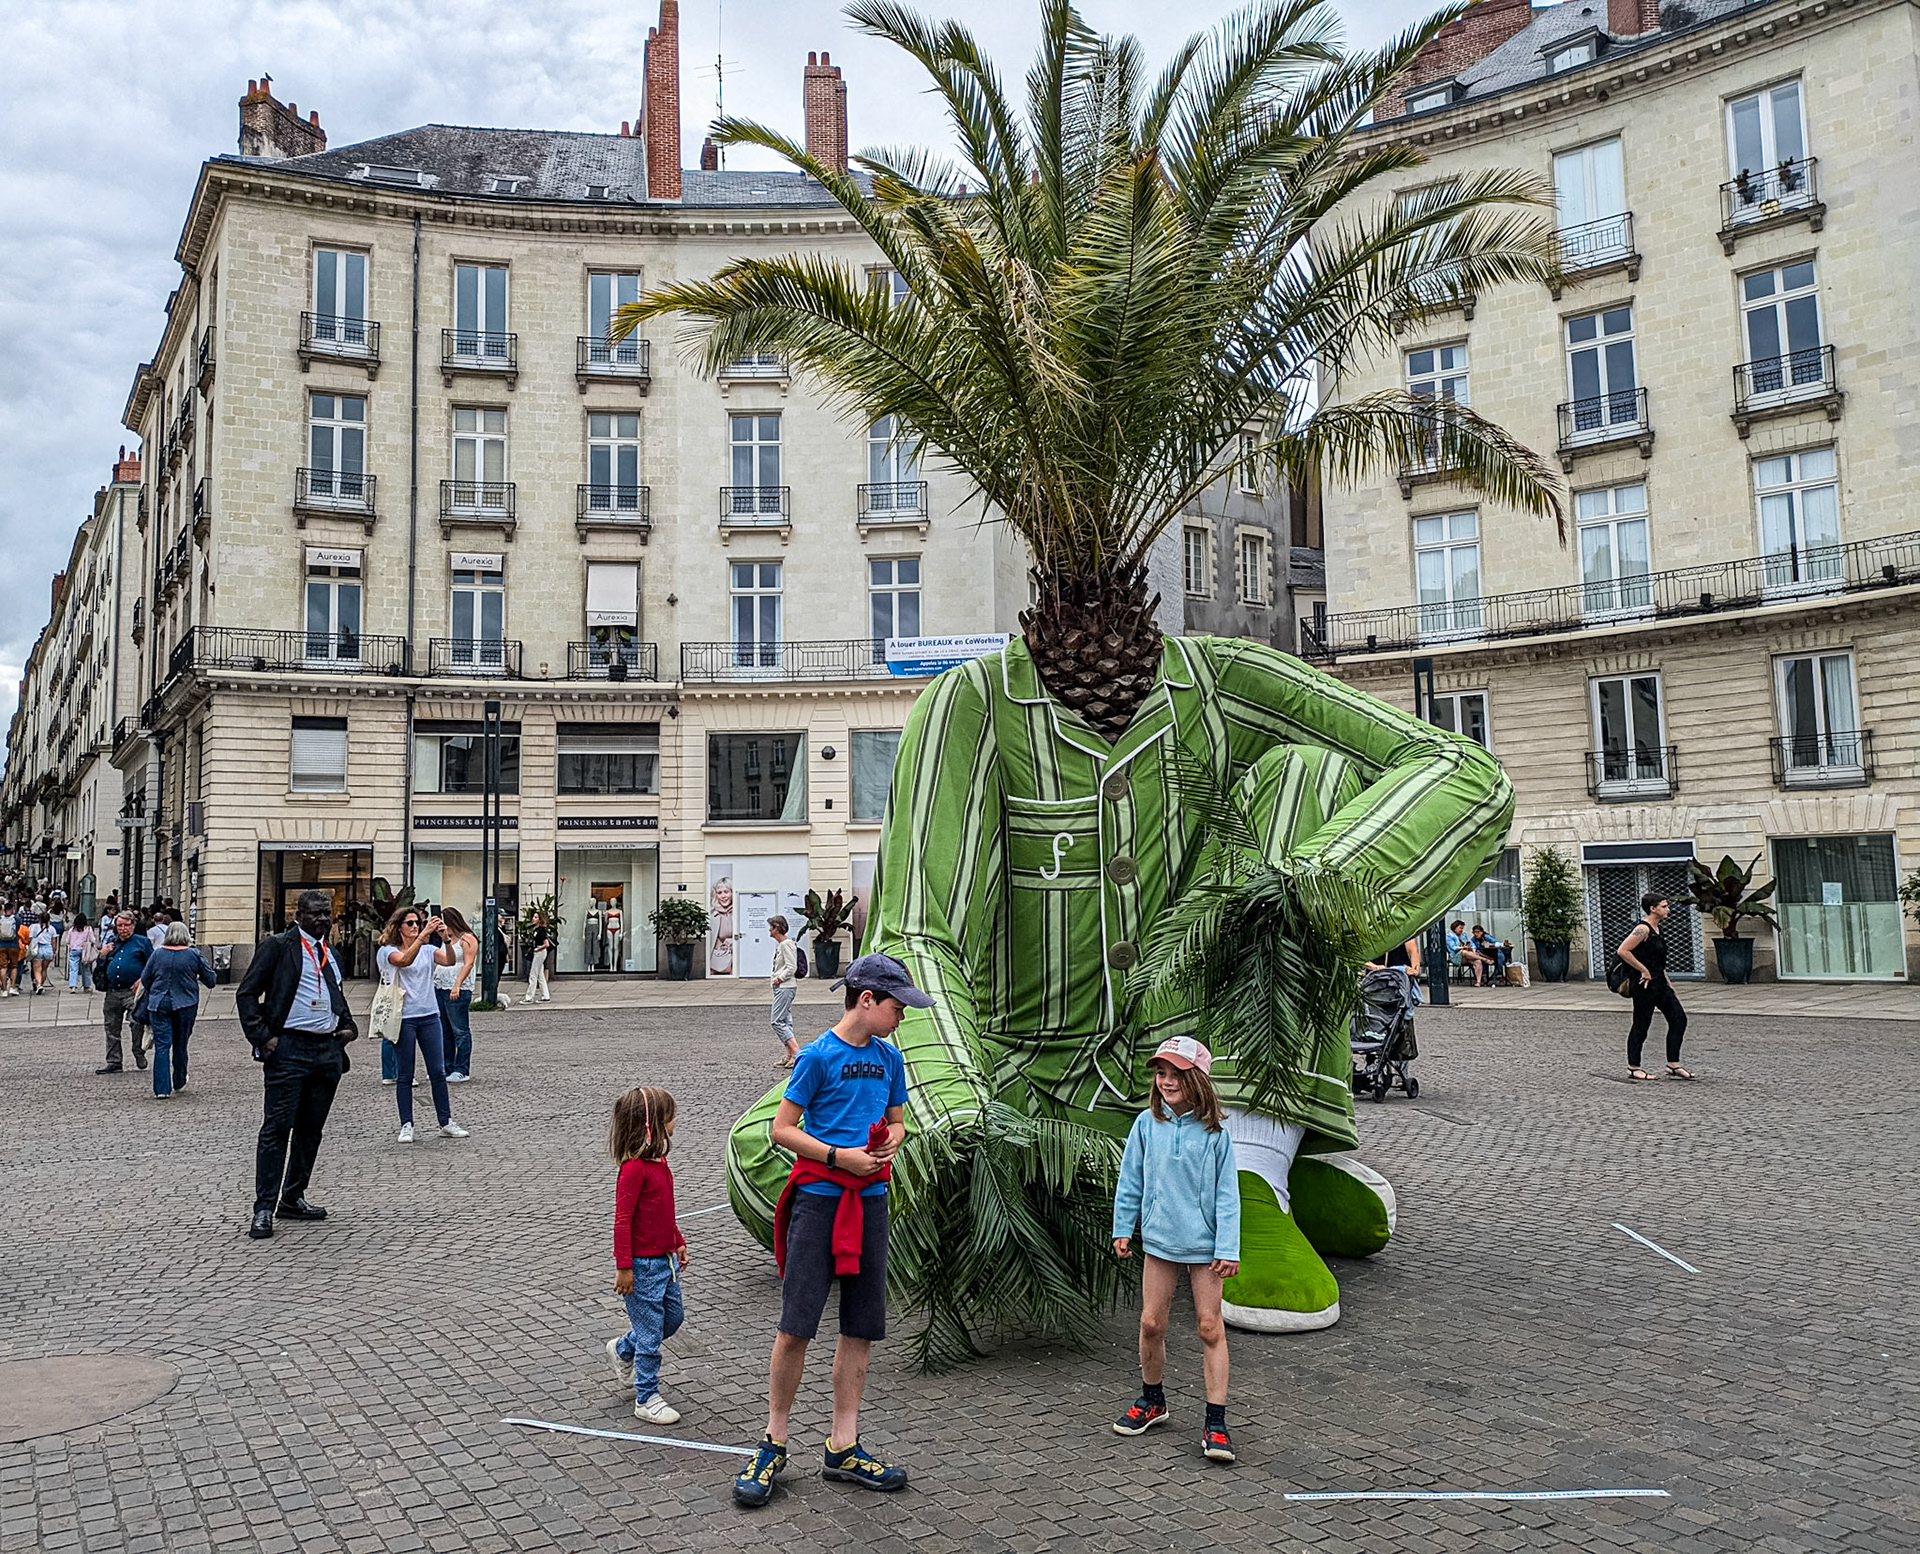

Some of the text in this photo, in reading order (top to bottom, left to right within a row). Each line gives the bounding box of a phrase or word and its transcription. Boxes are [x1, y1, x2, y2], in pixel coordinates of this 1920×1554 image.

[316, 551, 351, 562] Aurexia
[461, 556, 494, 566] Aurexia
[596, 613, 628, 621] Aurexia
[897, 640, 916, 648] louer
[917, 639, 953, 647] BUREAUX
[964, 636, 1004, 645] CoWorking
[841, 1060, 885, 1077] adidas
